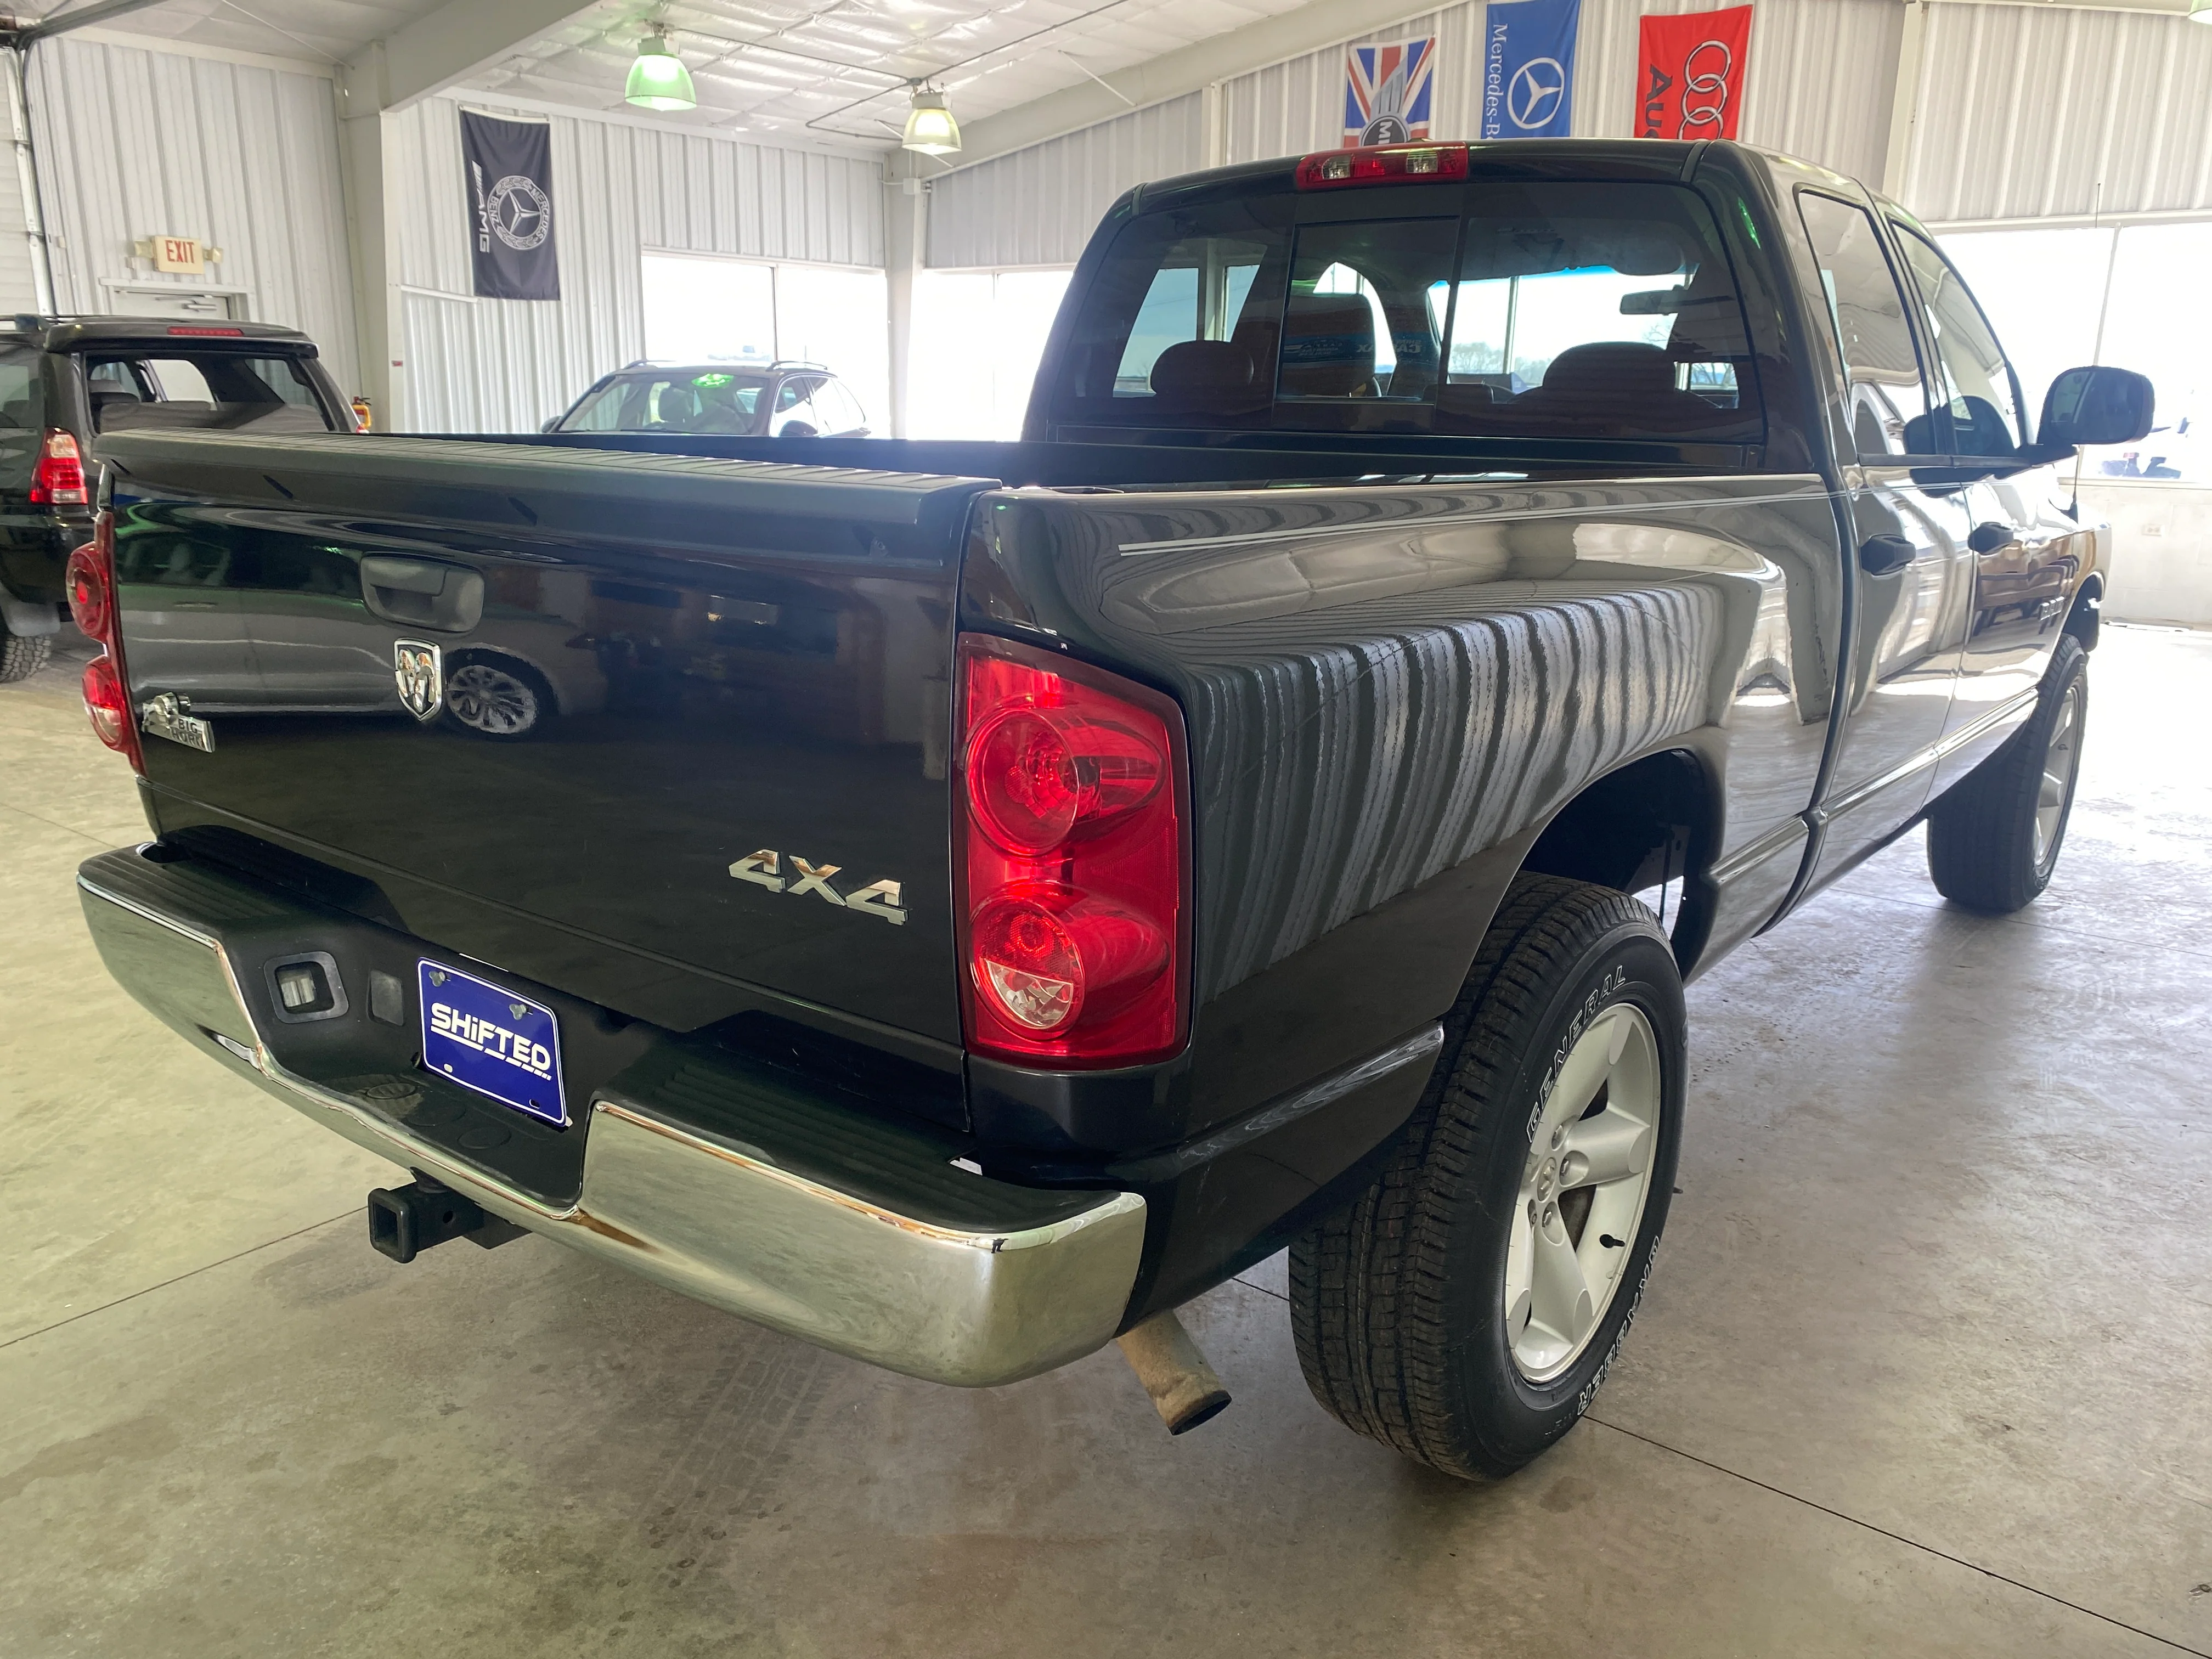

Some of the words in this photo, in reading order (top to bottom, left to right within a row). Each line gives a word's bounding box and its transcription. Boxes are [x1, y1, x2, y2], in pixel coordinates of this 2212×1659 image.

[1644, 64, 1673, 138] Au
[476, 189, 490, 253] AMG
[490, 195, 500, 227] BENZ
[531, 188, 548, 240] MERCEDES
[165, 239, 195, 263] EXIT
[171, 727, 205, 749] HORN
[178, 718, 198, 733] BIG
[729, 849, 909, 926] 4X4
[1526, 964, 1626, 1143] GENERAL
